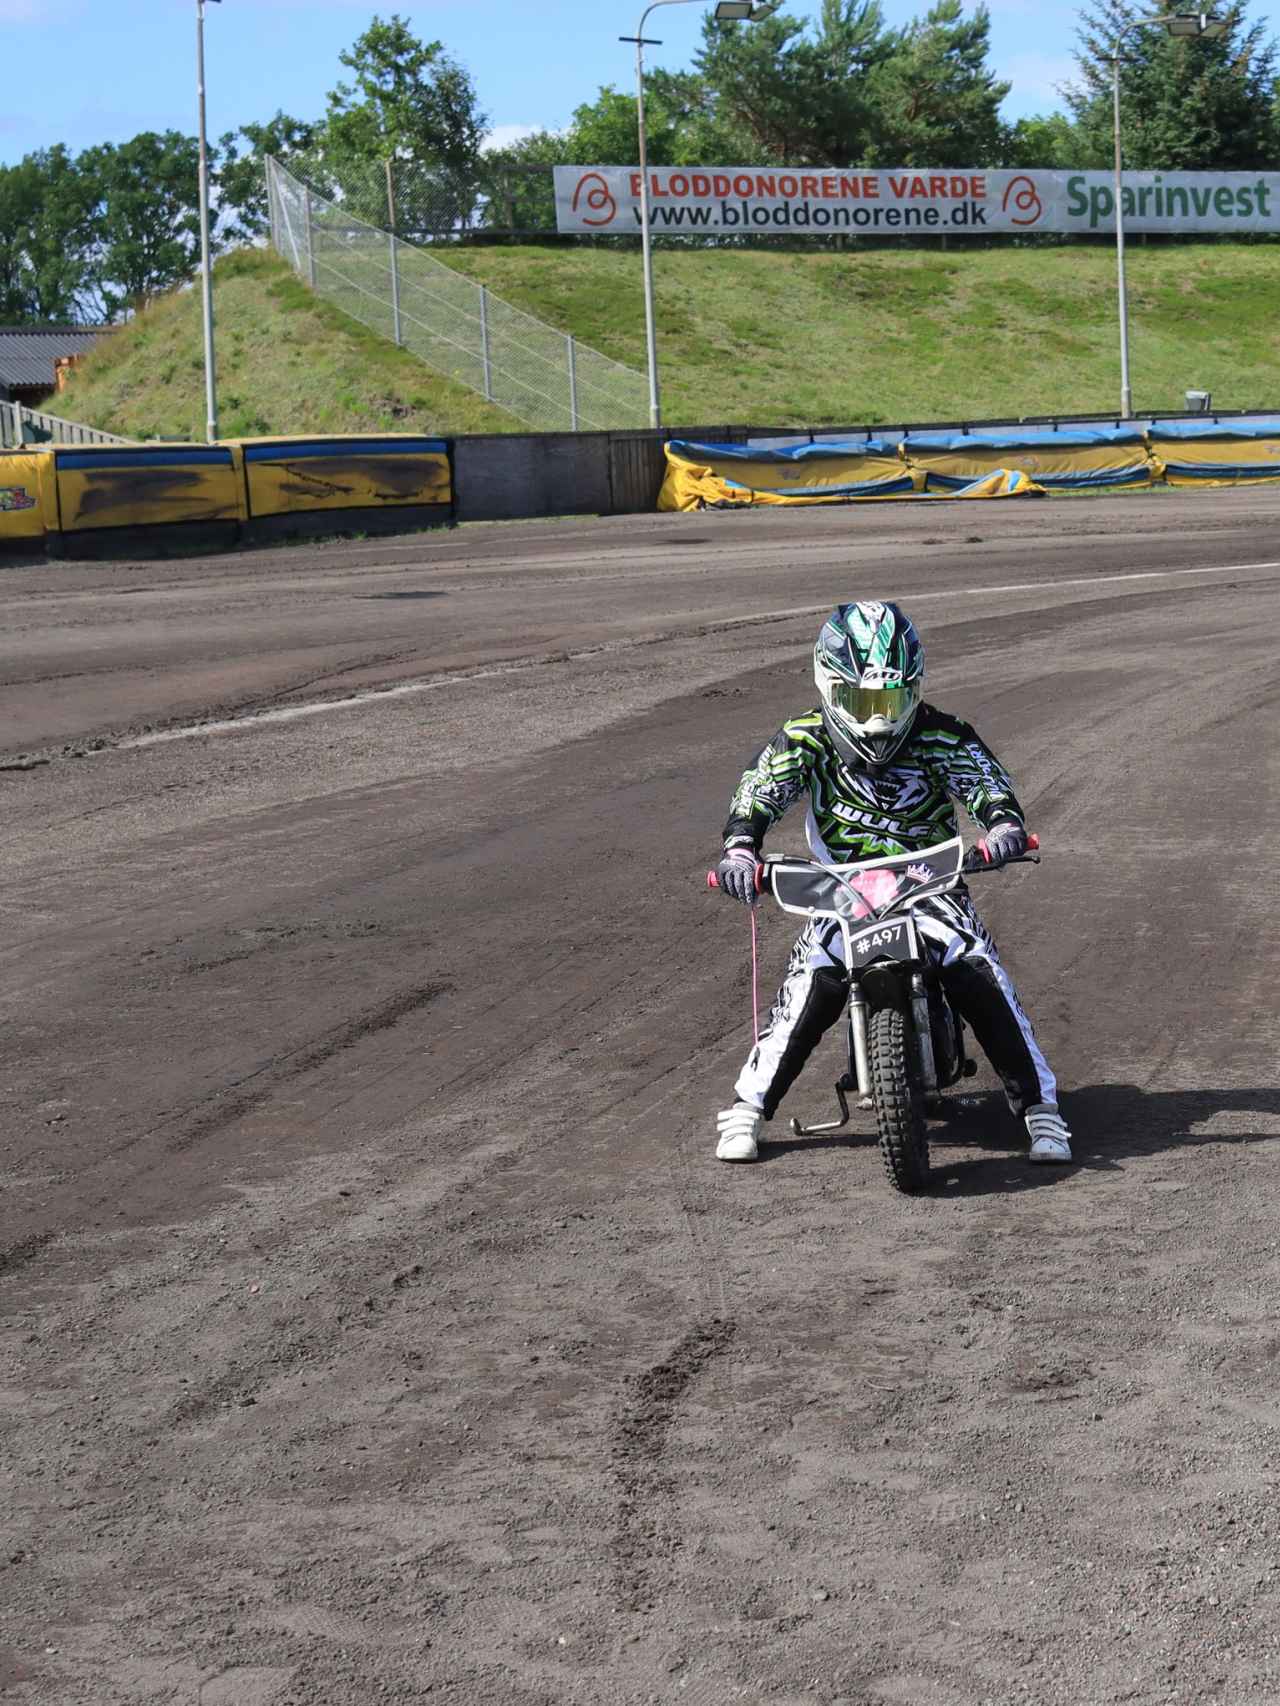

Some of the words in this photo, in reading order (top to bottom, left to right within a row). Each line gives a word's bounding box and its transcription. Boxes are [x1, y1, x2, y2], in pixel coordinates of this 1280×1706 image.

[629, 174, 880, 199] BLODDONORENE
[888, 175, 987, 199] VARDE
[632, 200, 987, 227] www.bloddonorene.dk
[1066, 175, 1271, 229] Sparinvest
[832, 801, 934, 838] WULF
[856, 926, 902, 955] #497
